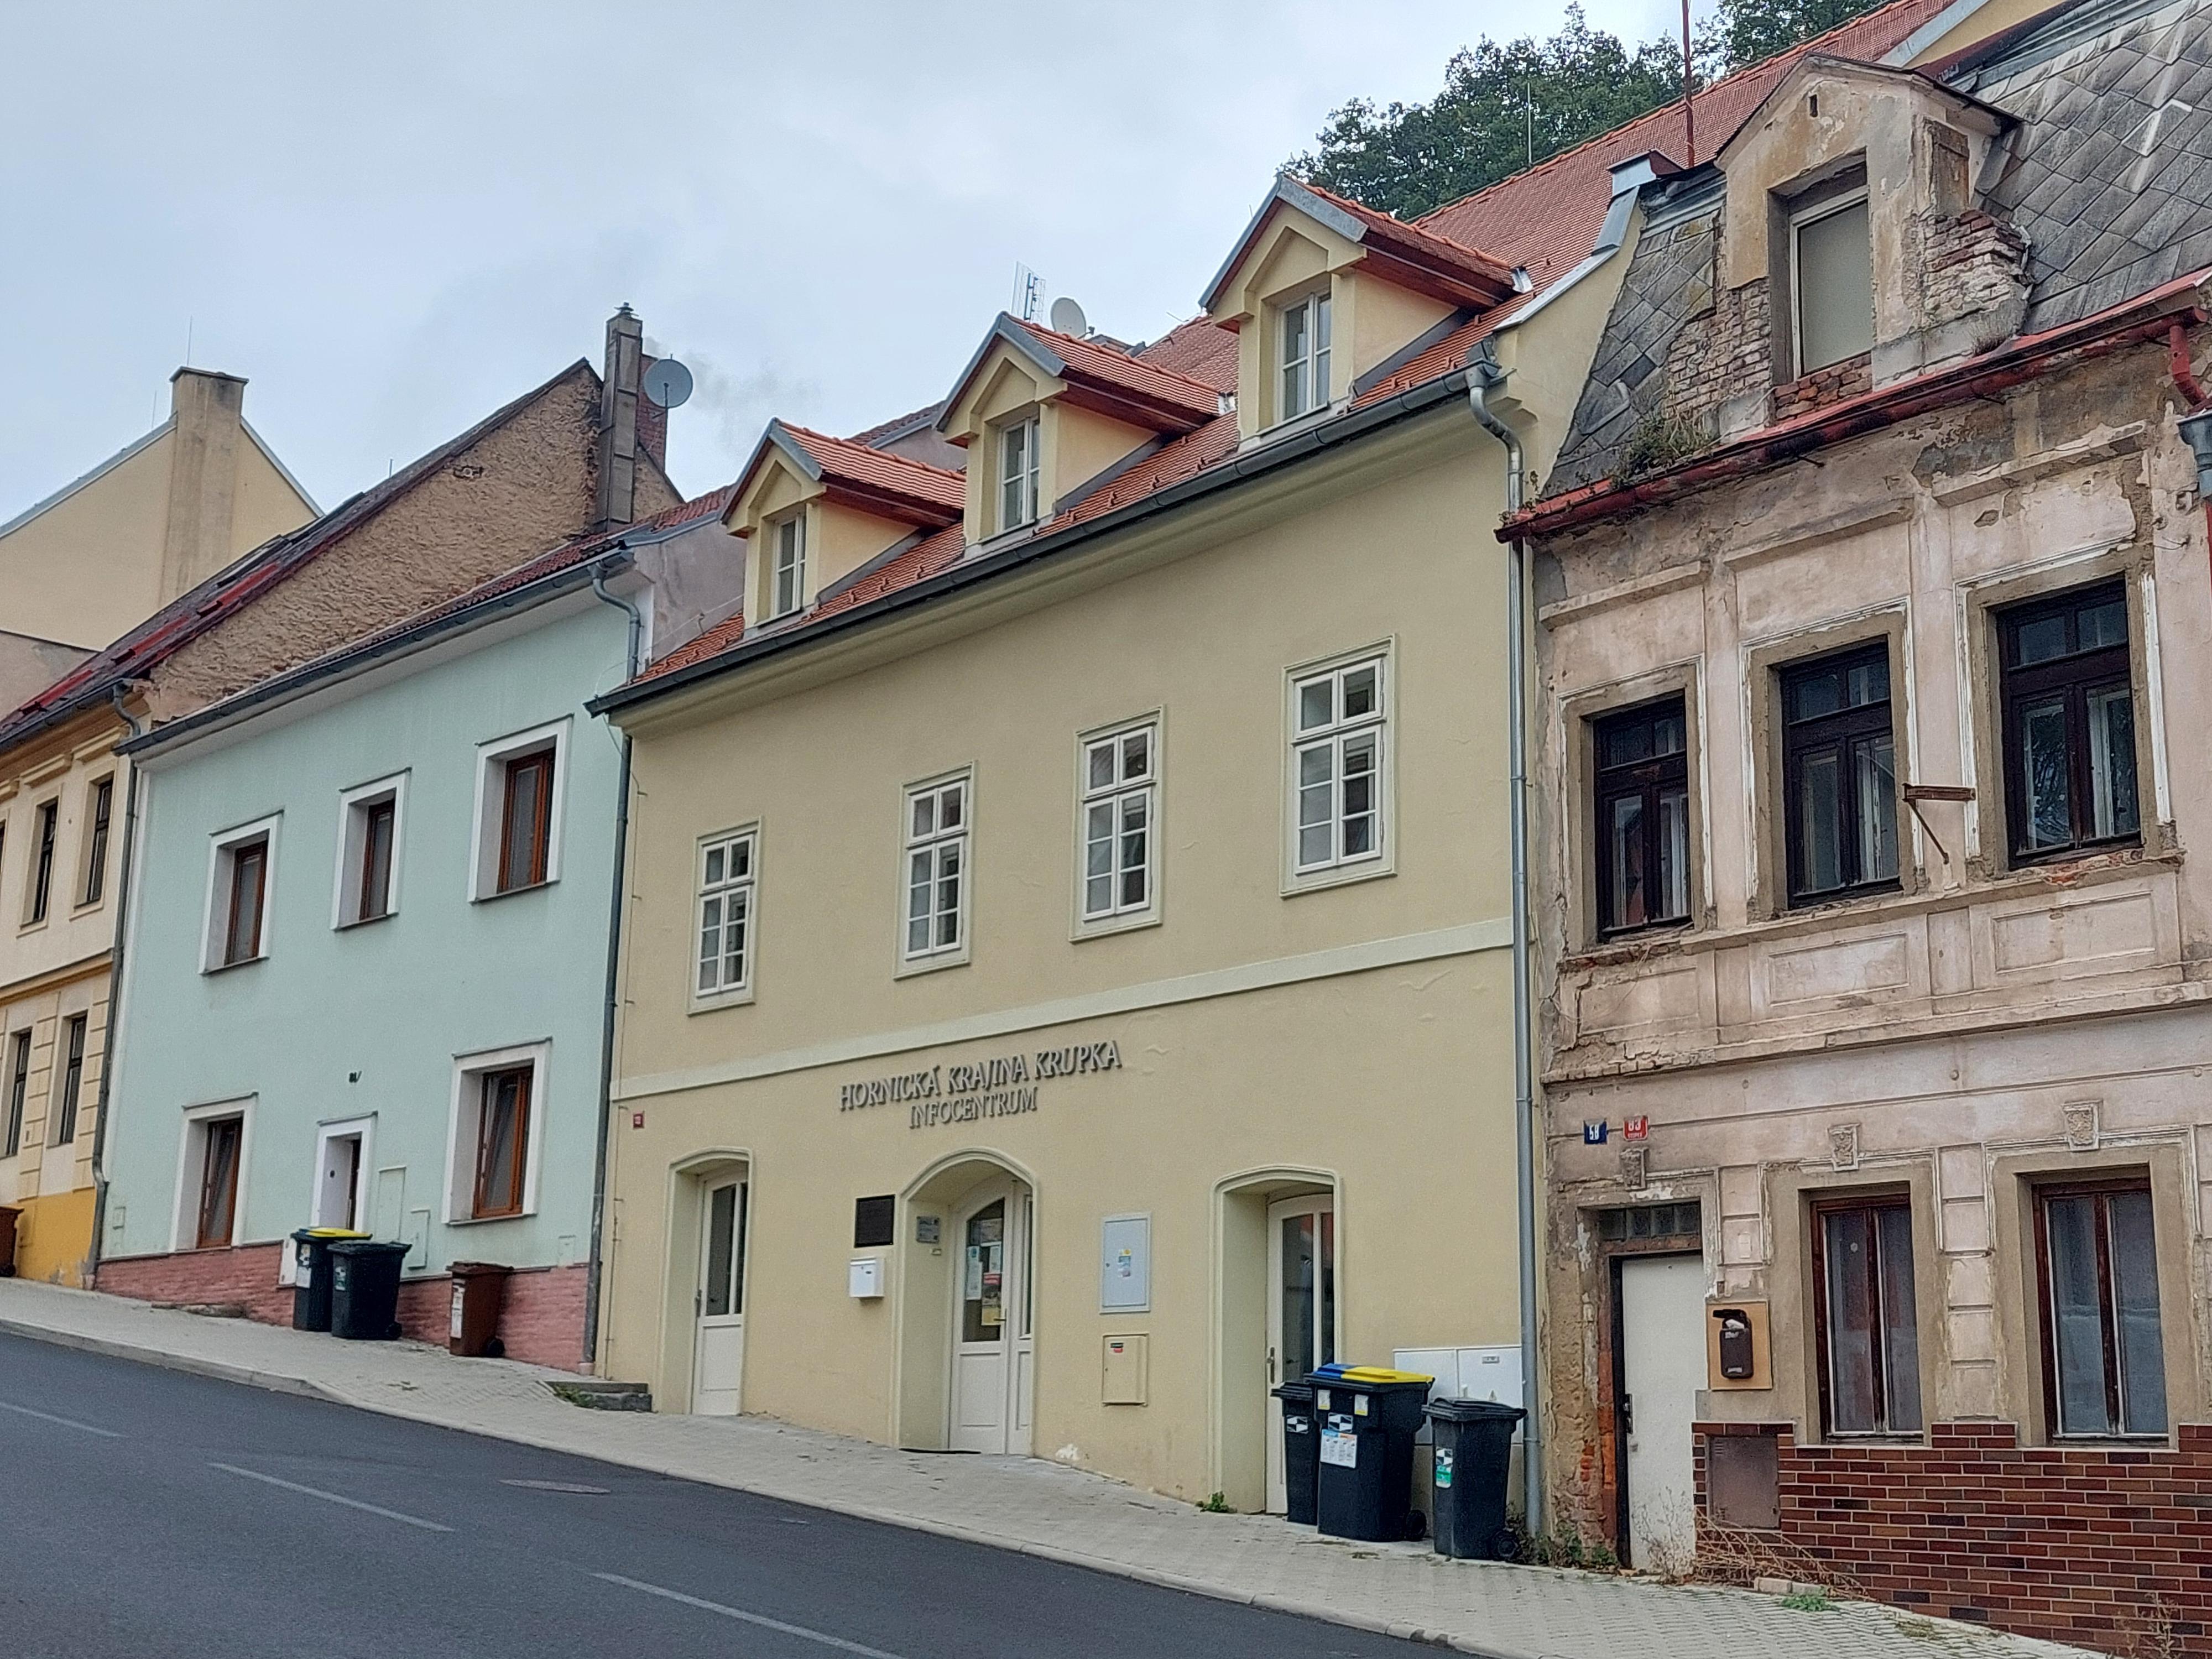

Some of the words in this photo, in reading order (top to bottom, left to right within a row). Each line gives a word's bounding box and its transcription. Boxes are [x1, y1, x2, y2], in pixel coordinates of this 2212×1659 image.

[841, 1065, 941, 1112] HORNICKÁ
[947, 1054, 1029, 1094] KRAJINA
[1035, 1040, 1122, 1079] KRUPKA
[910, 1086, 1038, 1129] INFOCENTRUM
